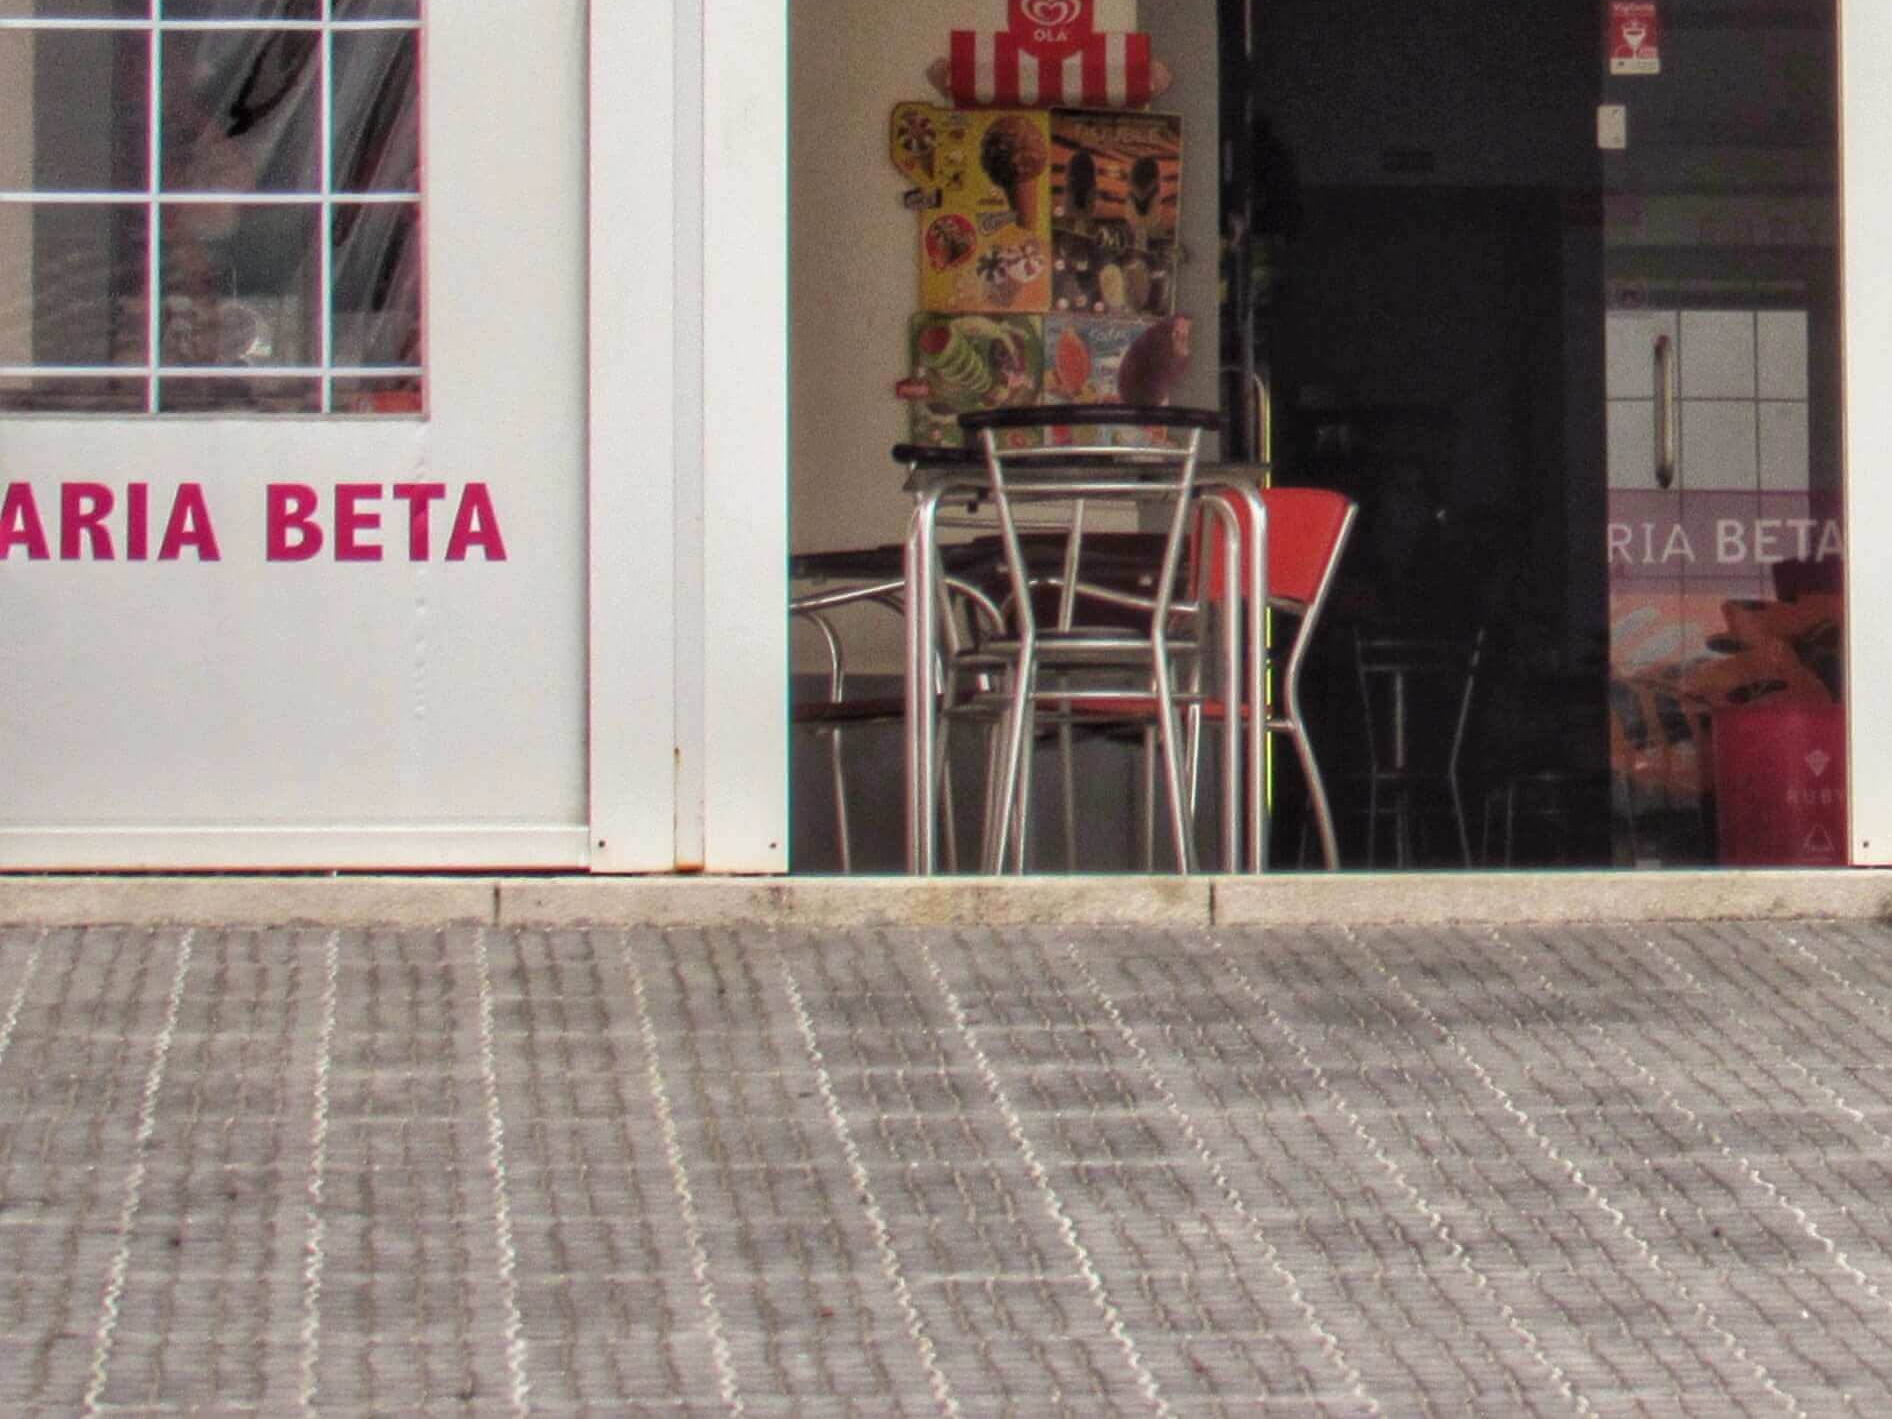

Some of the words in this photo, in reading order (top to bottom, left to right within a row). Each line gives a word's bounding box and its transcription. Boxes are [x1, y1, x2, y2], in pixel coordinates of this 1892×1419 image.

[0, 482, 220, 561] ARIA
[266, 482, 507, 561] BETA
[1717, 519, 1843, 564] BETA
